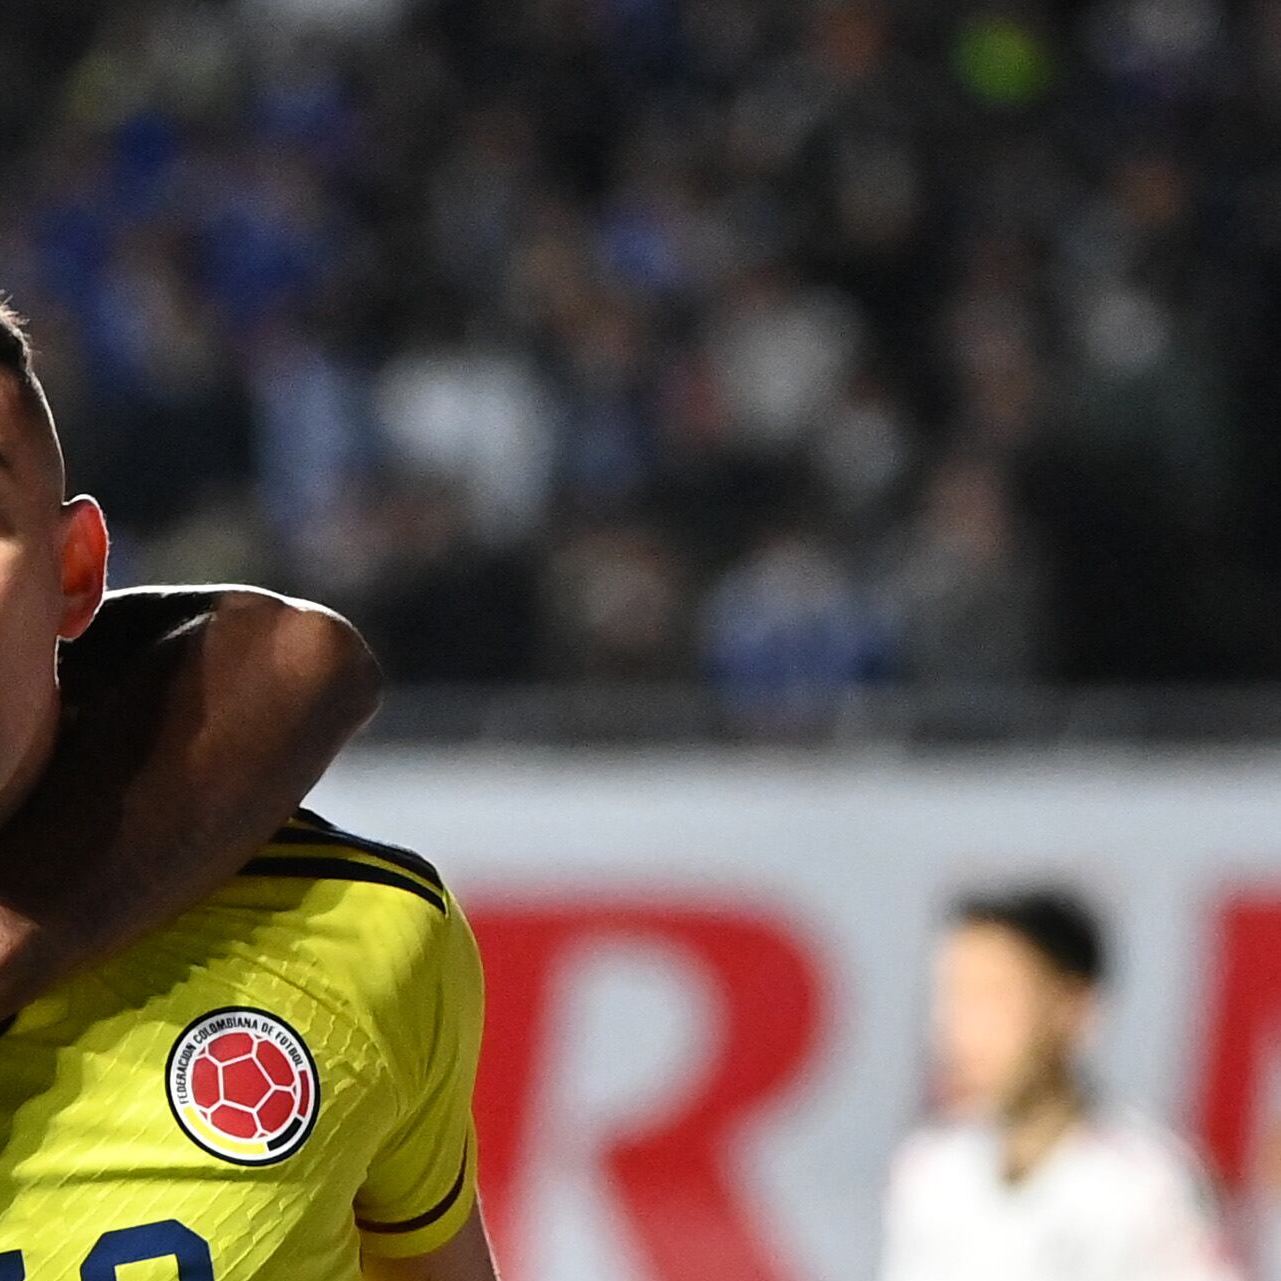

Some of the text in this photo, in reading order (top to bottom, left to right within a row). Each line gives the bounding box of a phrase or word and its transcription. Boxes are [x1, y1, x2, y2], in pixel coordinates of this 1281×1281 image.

[176, 1017, 304, 1104] FEDERACION COLOMBIANA DE FUTBOL
